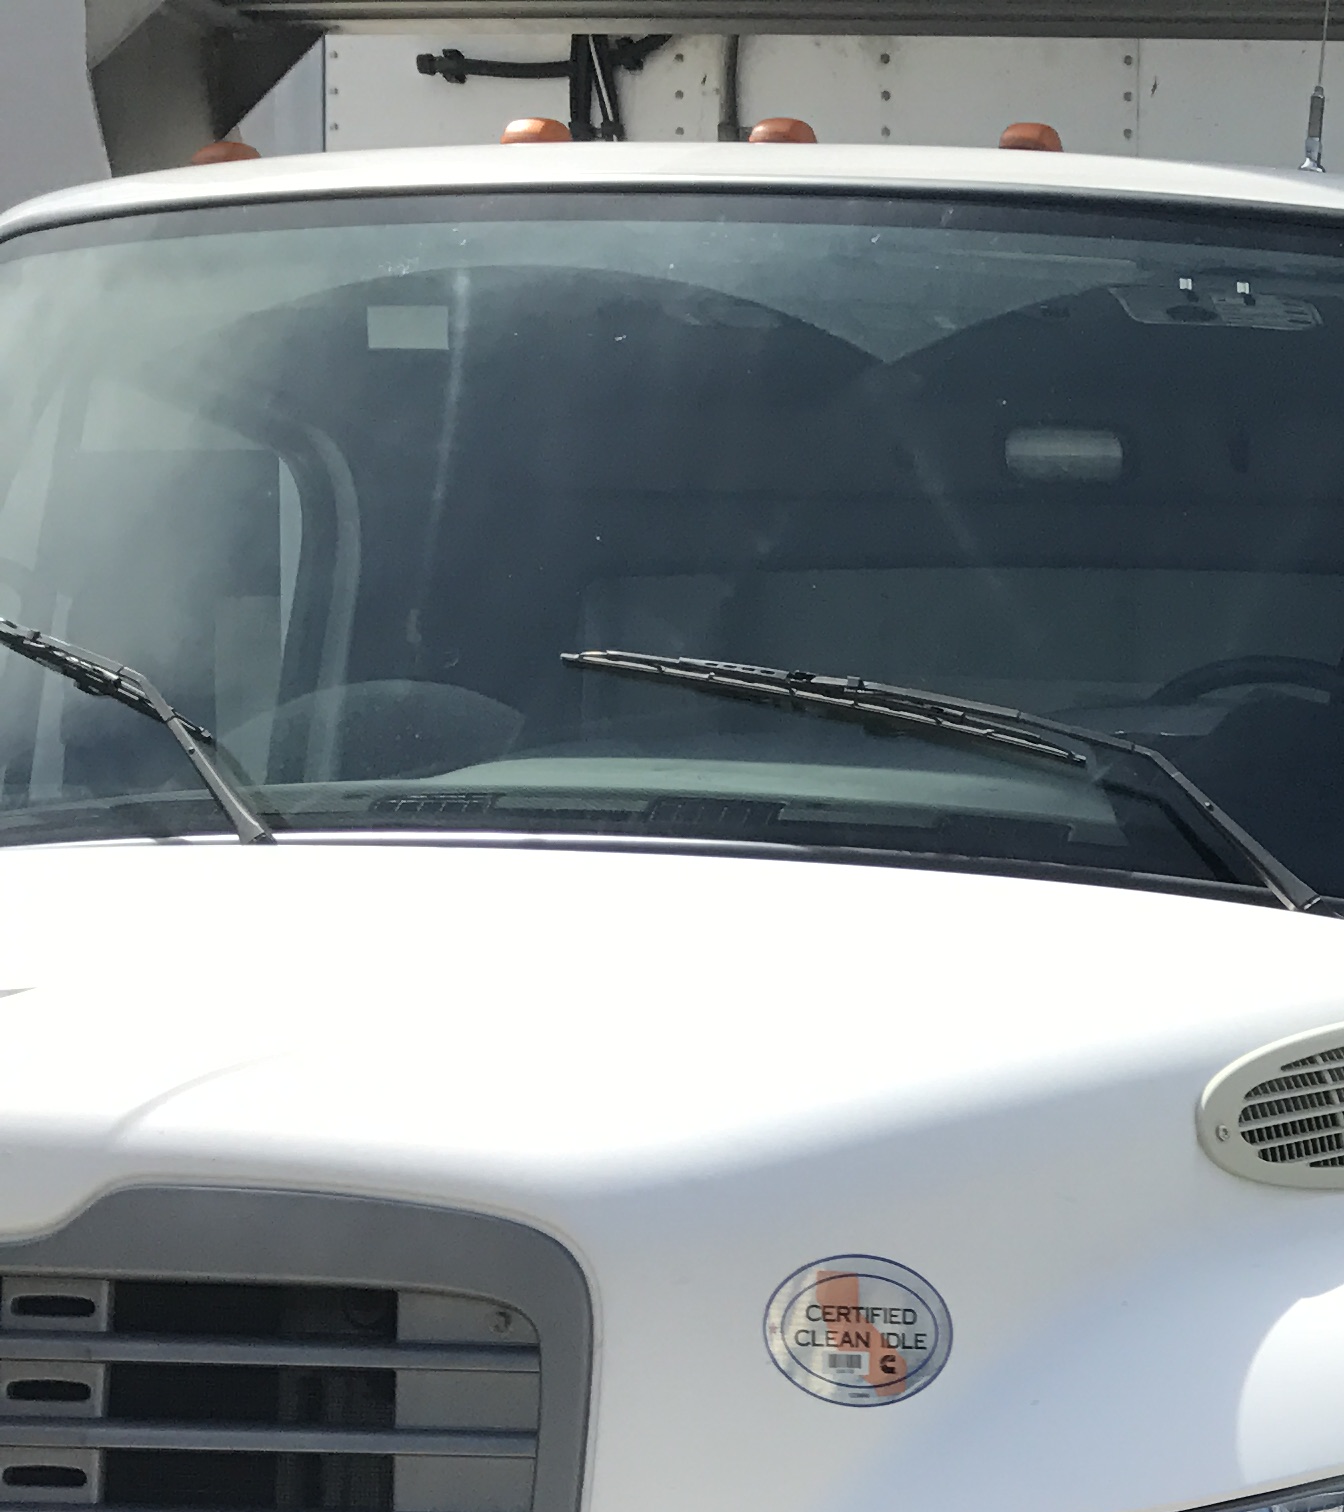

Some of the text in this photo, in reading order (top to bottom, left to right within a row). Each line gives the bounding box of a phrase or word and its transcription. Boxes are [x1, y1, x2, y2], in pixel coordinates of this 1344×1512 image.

[805, 1304, 917, 1325] CERTIFIED
[794, 1329, 928, 1350] CLEAN IDLE
